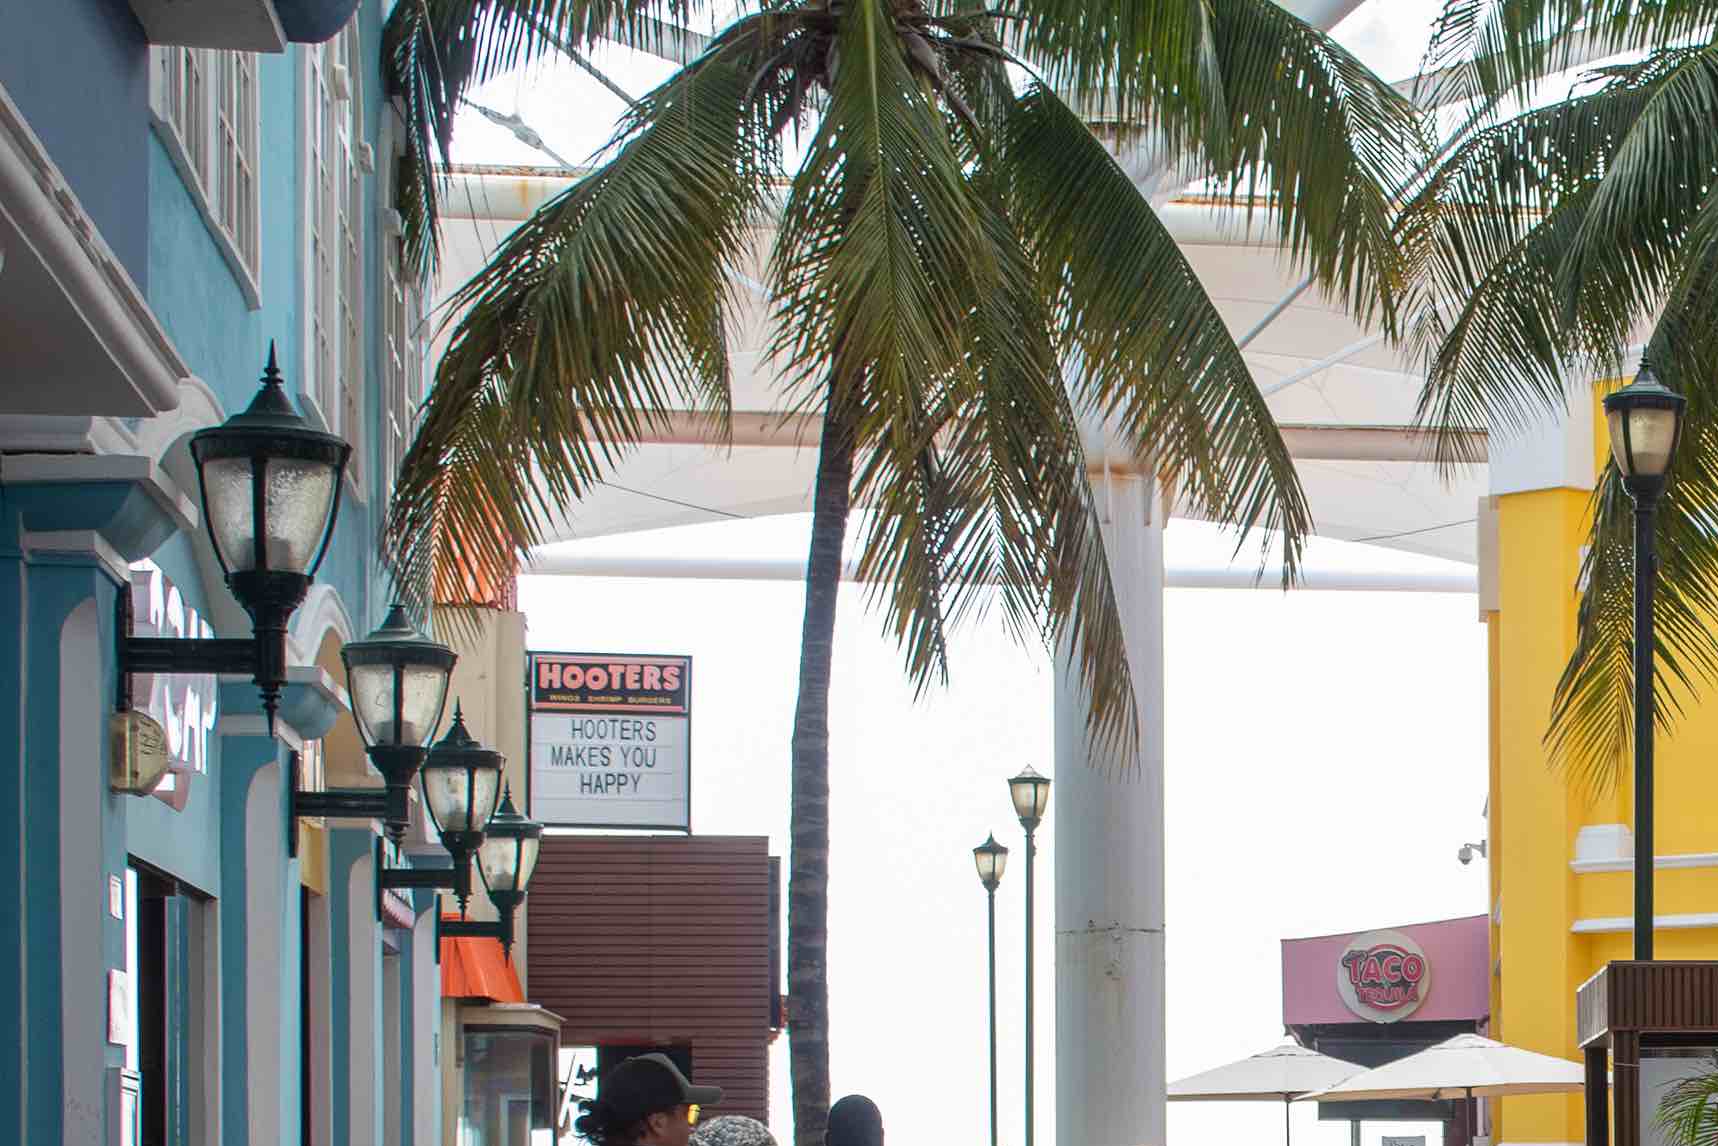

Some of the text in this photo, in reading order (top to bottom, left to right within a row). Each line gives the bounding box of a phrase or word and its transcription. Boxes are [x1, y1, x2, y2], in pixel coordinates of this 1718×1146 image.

[539, 663, 681, 690] HOOTERS
[571, 719, 657, 741] HOOTERS
[551, 746, 656, 768] MAKES YOU
[580, 773, 641, 795] HAPPY
[1343, 951, 1424, 984] TACO
